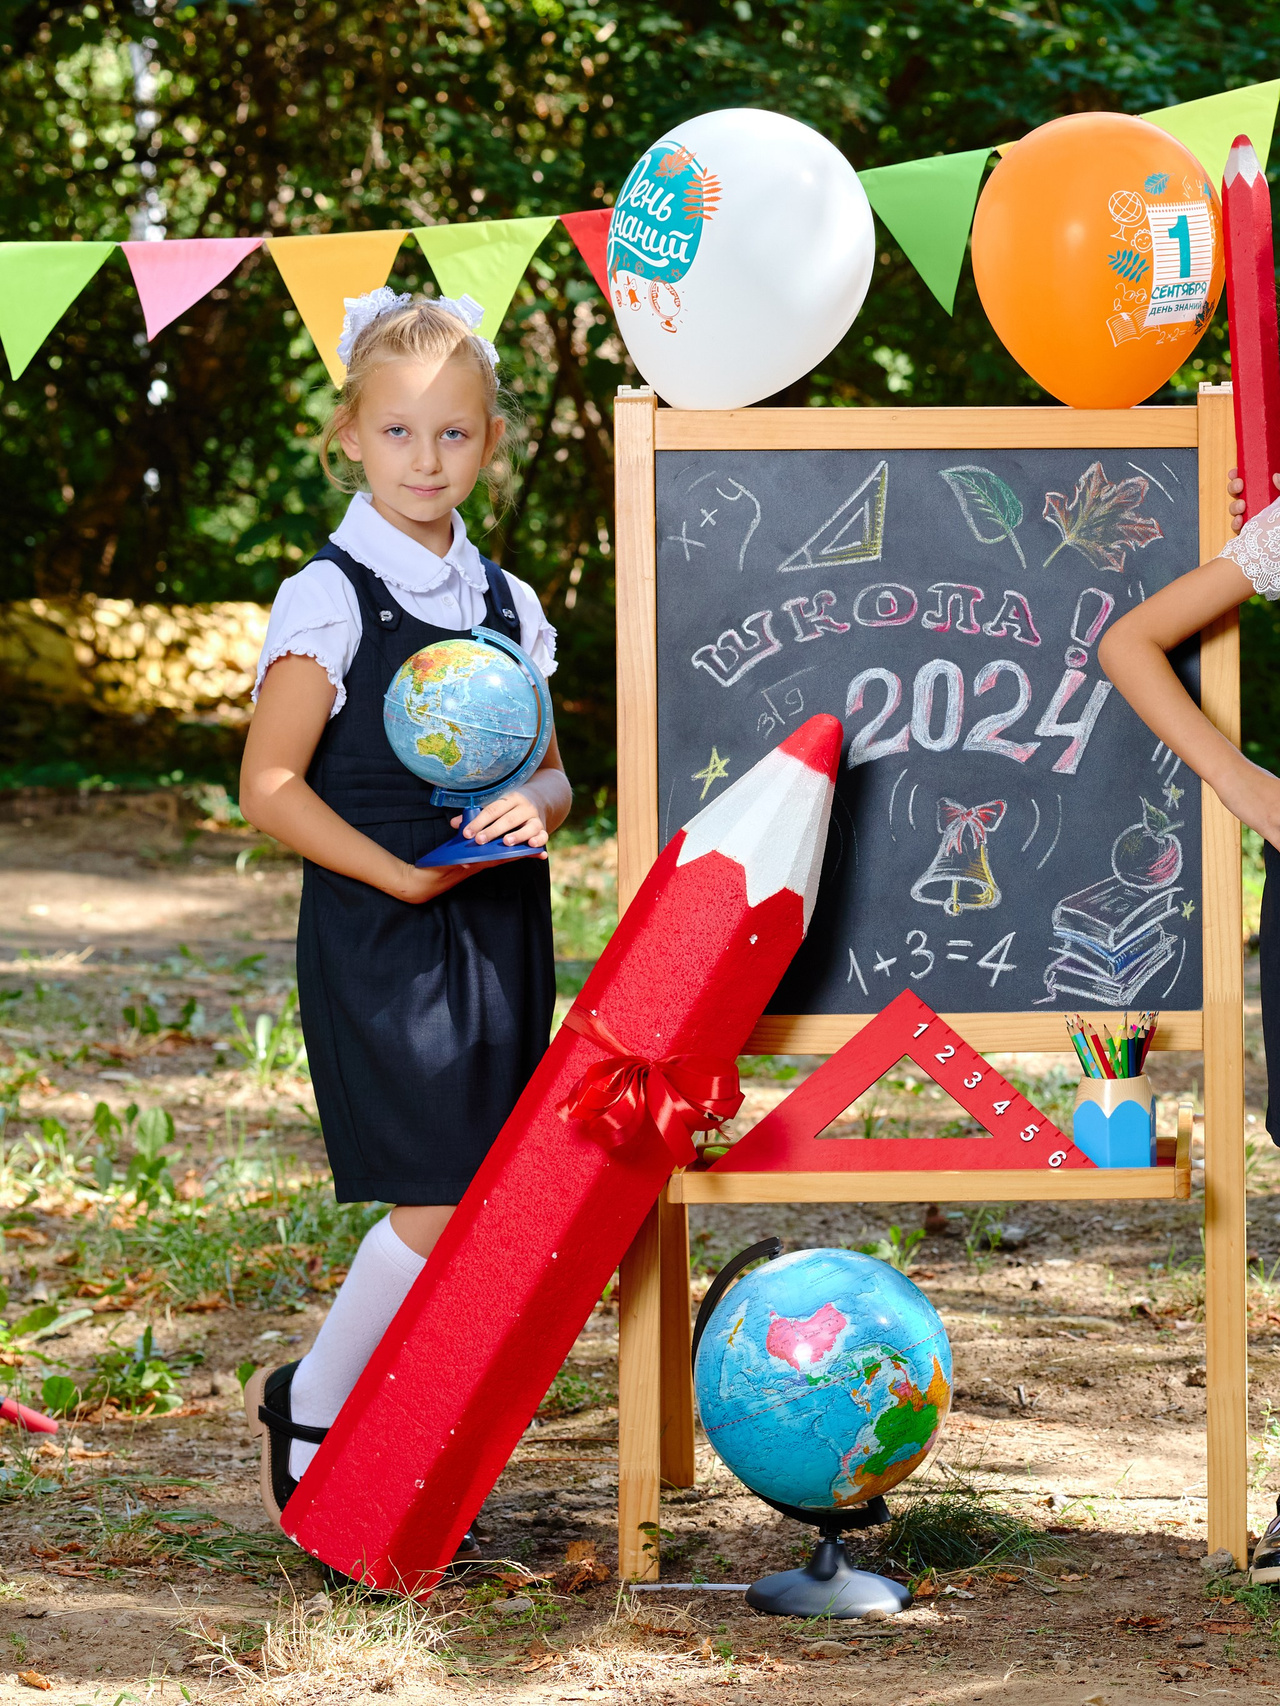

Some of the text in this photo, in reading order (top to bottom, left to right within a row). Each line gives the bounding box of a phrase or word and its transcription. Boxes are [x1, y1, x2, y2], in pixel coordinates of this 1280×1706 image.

[1168, 214, 1191, 279] 1
[1148, 304, 1173, 317] ДЕНЬ
[1151, 281, 1207, 300] СЕНТЯБРЯ
[845, 659, 1114, 776] 2024
[912, 1022, 1067, 1168] 1 2 3 4 5 6
